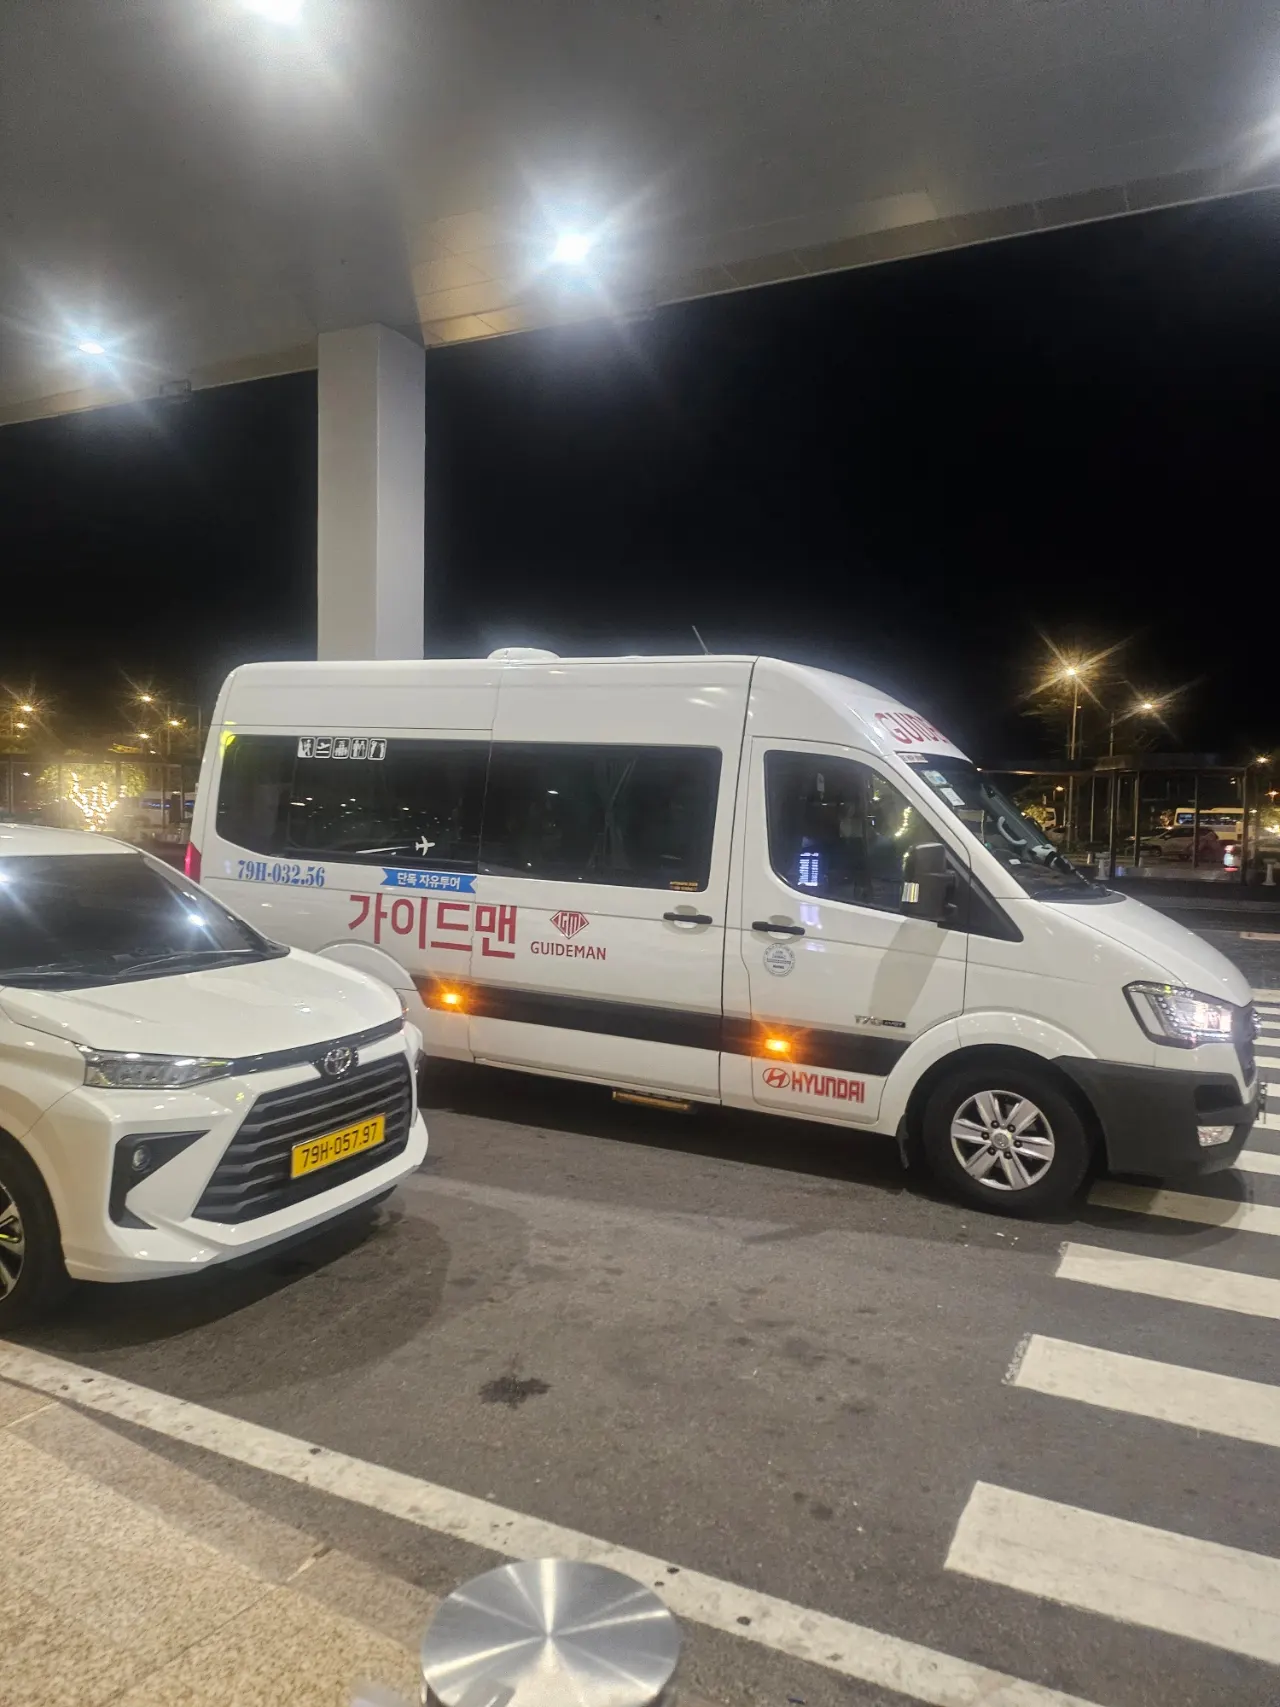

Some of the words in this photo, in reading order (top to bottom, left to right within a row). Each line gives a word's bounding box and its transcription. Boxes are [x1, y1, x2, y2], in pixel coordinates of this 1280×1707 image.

[237, 859, 325, 888] 79H-032.56
[396, 872, 417, 889] 단독
[418, 874, 461, 890] 자유투어
[348, 892, 518, 960] 가이드맨
[530, 940, 607, 961] GUIDEMAN
[791, 1070, 866, 1104] HYUNDAI
[301, 1122, 378, 1169] 79H-057.97
